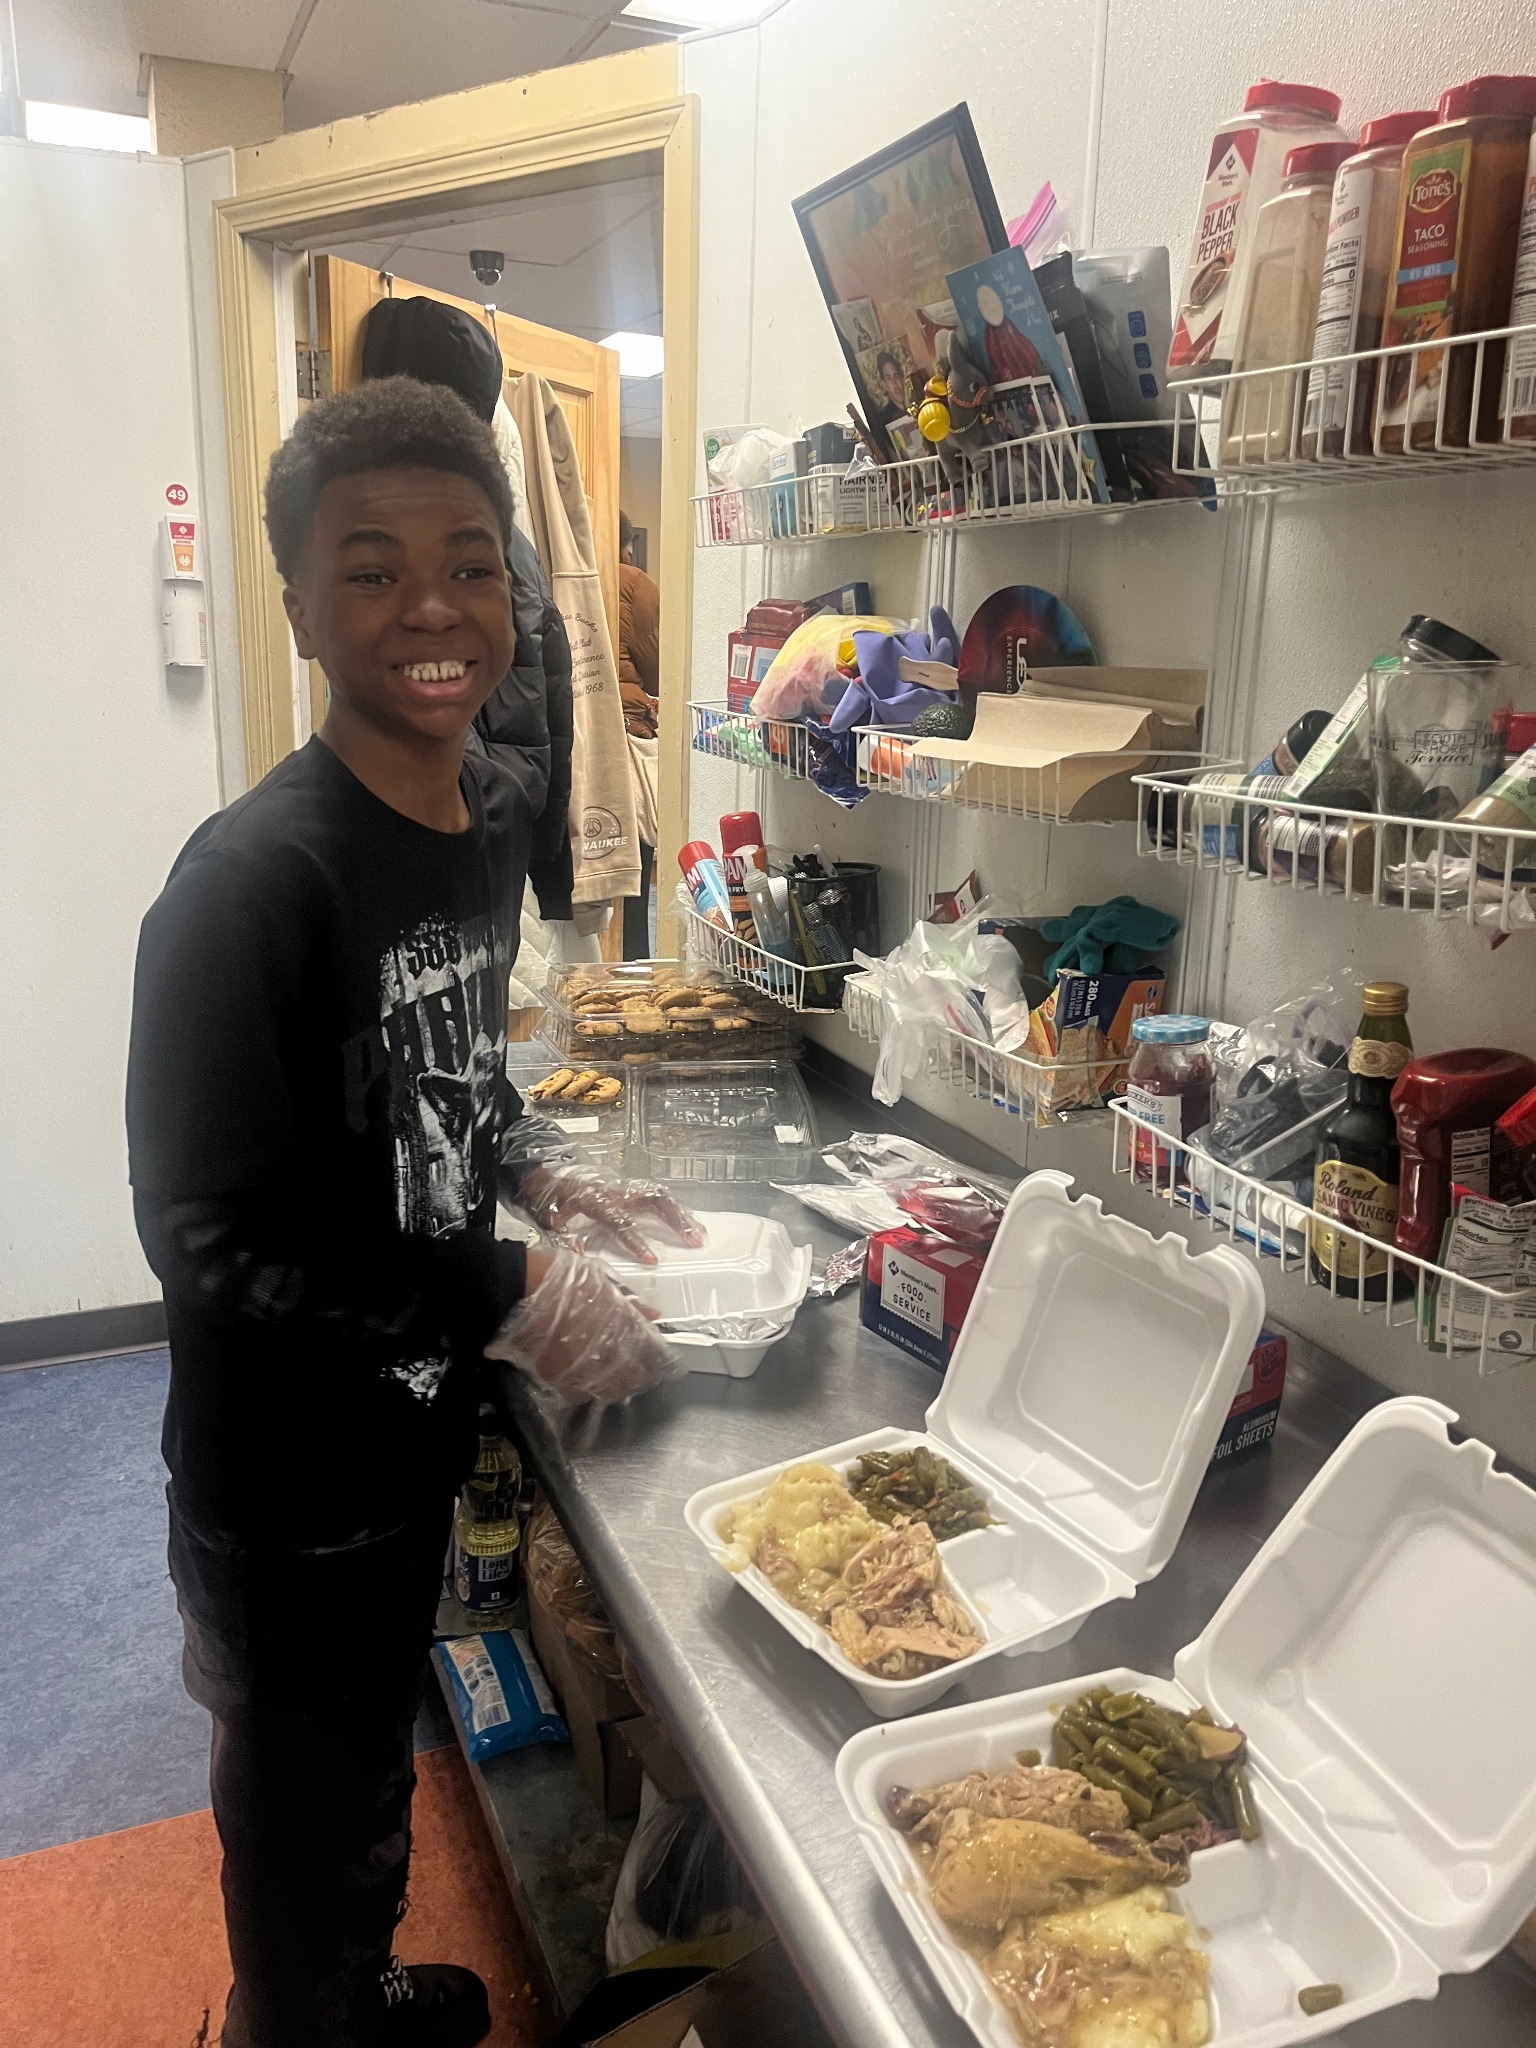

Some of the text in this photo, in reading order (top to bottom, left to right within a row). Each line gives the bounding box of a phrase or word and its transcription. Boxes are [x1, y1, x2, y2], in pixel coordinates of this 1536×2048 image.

[1415, 181, 1452, 203] Tone's
[1201, 201, 1241, 241] BLACK
[1414, 223, 1445, 242] TACO
[1196, 230, 1234, 264] PEPPER
[1407, 238, 1448, 255] SEASONING
[840, 474, 888, 486] HAIRNET
[167, 488, 187, 501] 49
[840, 486, 885, 494] LIGHTWIGT
[586, 681, 605, 694] 1968
[1423, 732, 1467, 744] SOUTH
[1405, 751, 1471, 765] Terrace
[1422, 744, 1468, 755] SHORE
[1084, 980, 1100, 1017] 280 BAGS
[1139, 1111, 1165, 1125] FREE
[1319, 1170, 1379, 1200] Roland
[1456, 1225, 1489, 1243] Calories
[901, 1282, 924, 1301] FOOD
[893, 1293, 931, 1323] SERVICE
[1236, 1420, 1275, 1451] SHEETS
